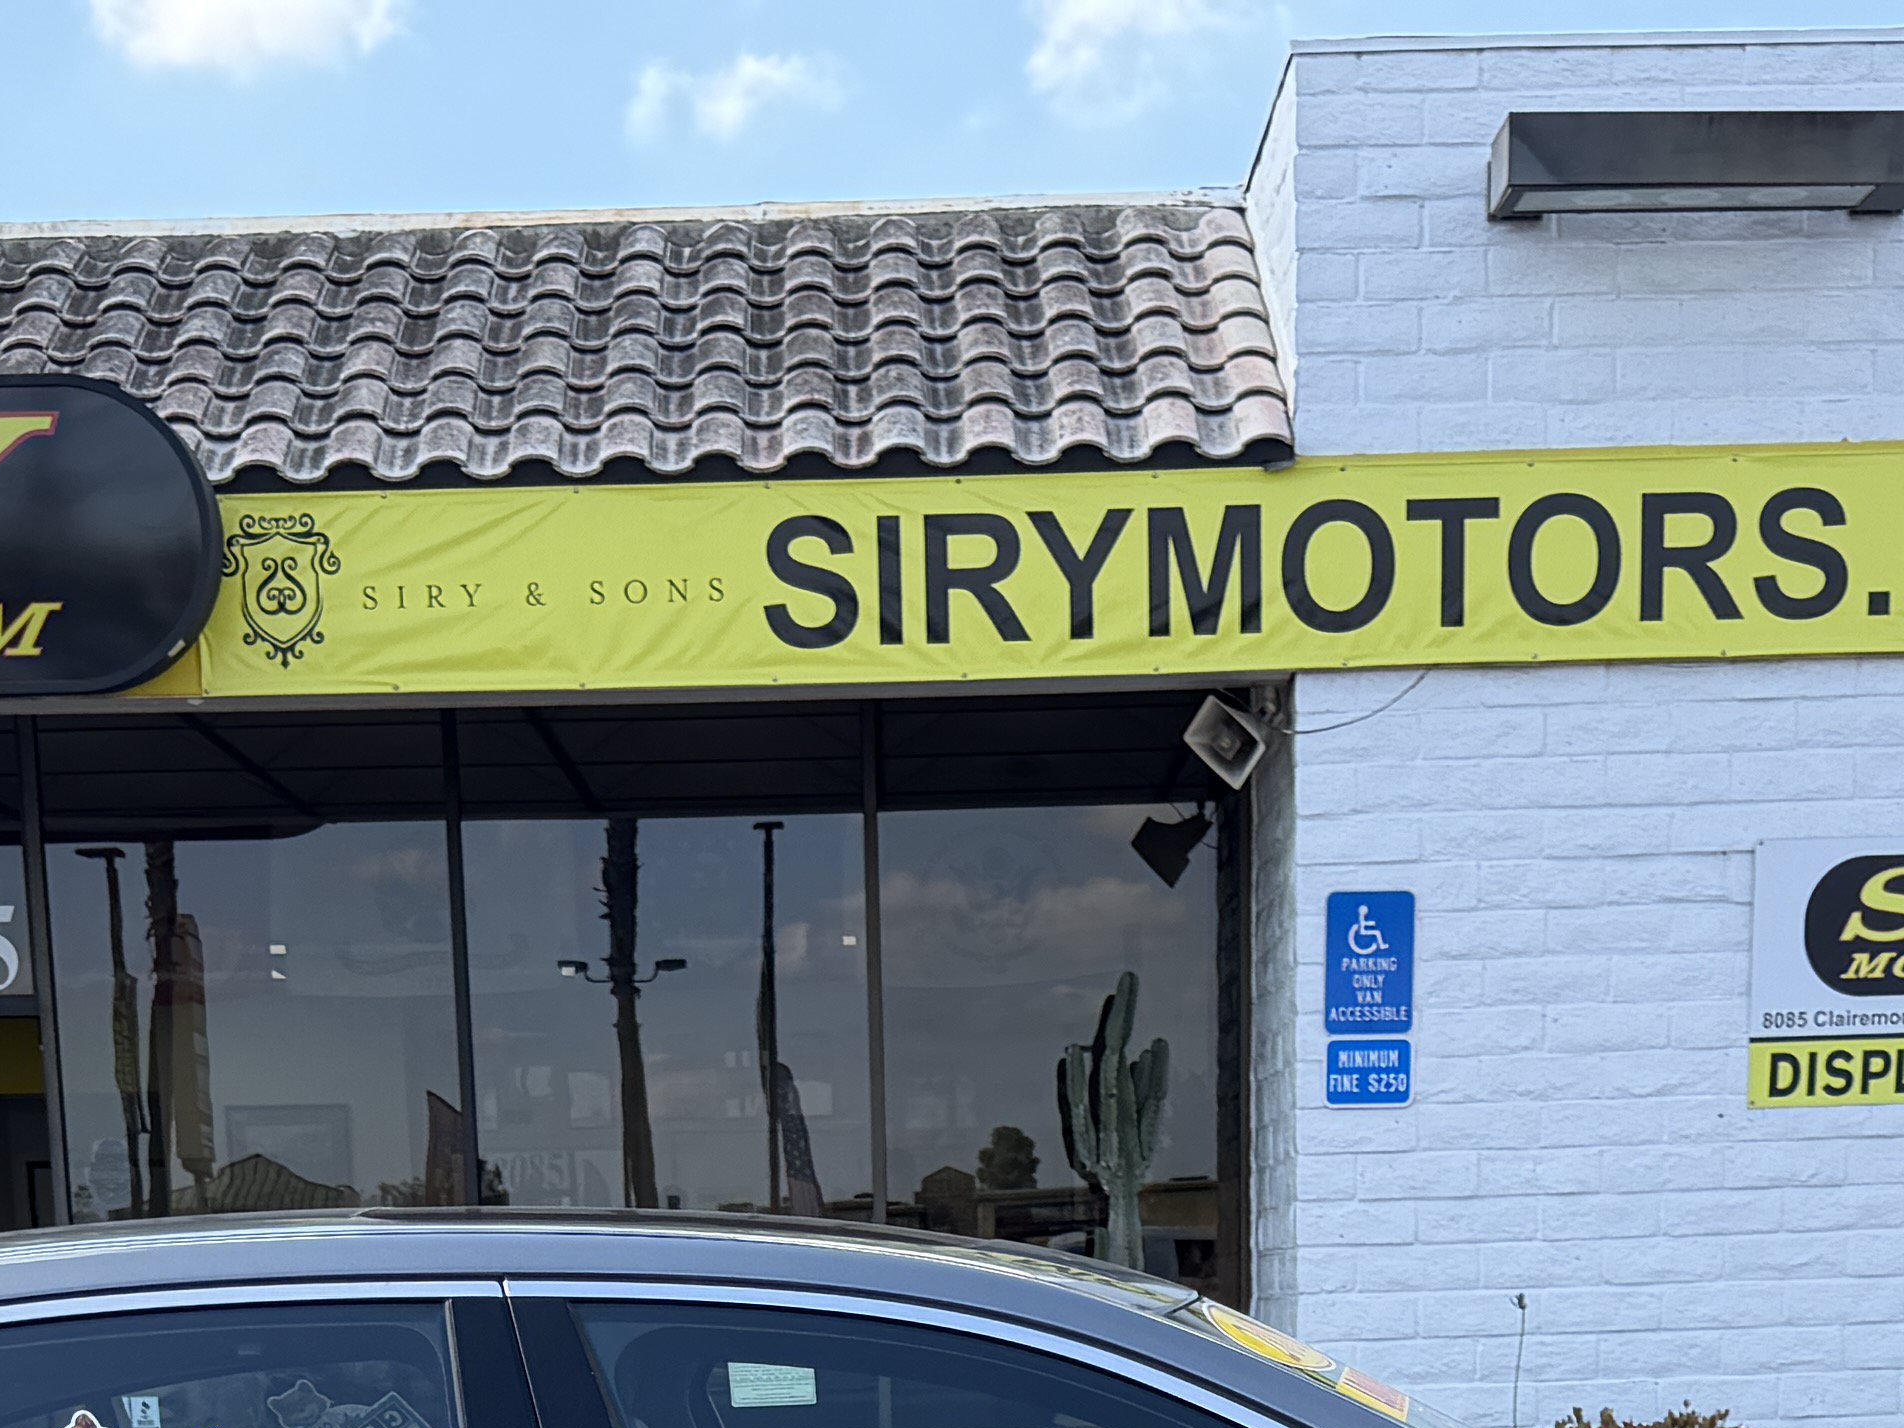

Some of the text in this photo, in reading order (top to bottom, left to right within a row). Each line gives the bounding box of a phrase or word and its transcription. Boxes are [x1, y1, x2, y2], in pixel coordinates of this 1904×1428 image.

[362, 576, 727, 611] SIRY & SONS
[1341, 957, 1397, 971] PARKING
[1352, 974, 1385, 988] ONLY
[1356, 990, 1383, 1004] VAN
[1328, 1006, 1408, 1022] ACCESSIBLE
[1762, 1011, 1807, 1030] 8085
[1338, 1050, 1399, 1069] MINIMUM
[1329, 1073, 1407, 1094] FINE $250
